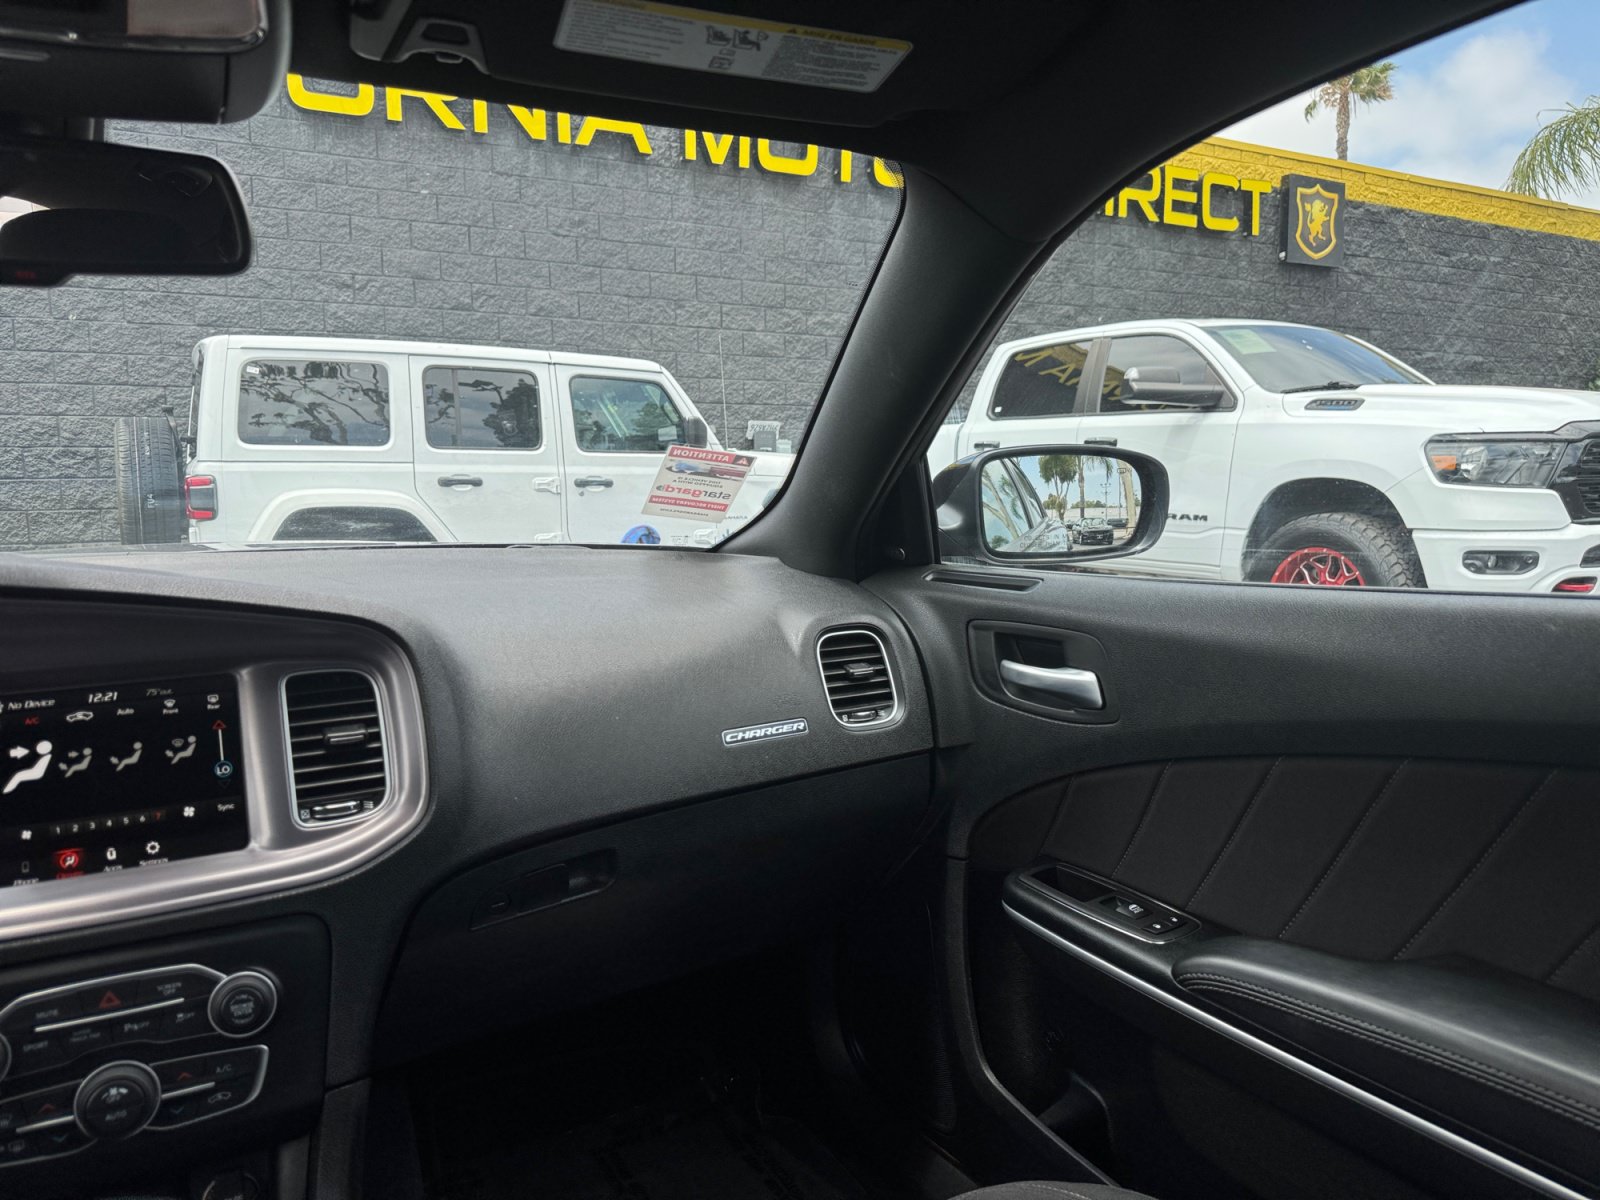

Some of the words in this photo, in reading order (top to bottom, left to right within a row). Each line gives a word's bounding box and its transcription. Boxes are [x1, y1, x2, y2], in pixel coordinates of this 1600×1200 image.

[1166, 512, 1208, 522] RAM
[88, 691, 118, 704] 12:21
[8, 702, 22, 710] No
[725, 722, 805, 742] CHARGER
[105, 1110, 128, 1121] AUTO
